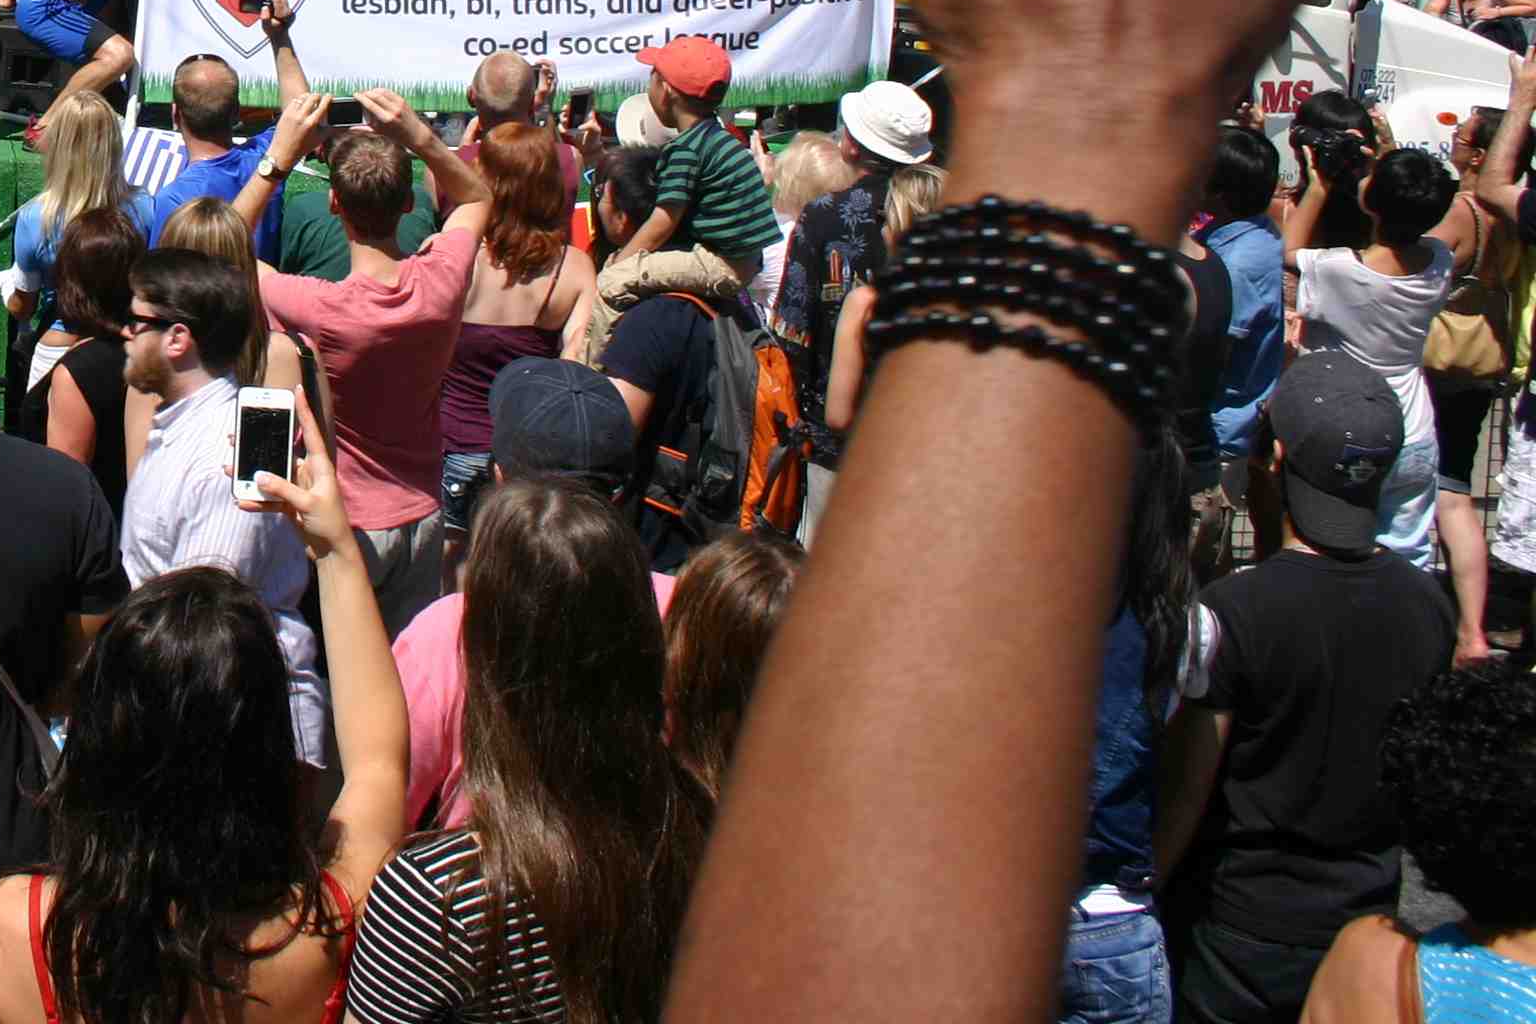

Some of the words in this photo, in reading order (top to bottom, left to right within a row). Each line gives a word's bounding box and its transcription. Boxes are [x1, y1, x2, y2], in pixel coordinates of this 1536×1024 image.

[463, 30, 548, 56] co-ed
[559, 33, 653, 55] soccer
[665, 27, 760, 51] lue
